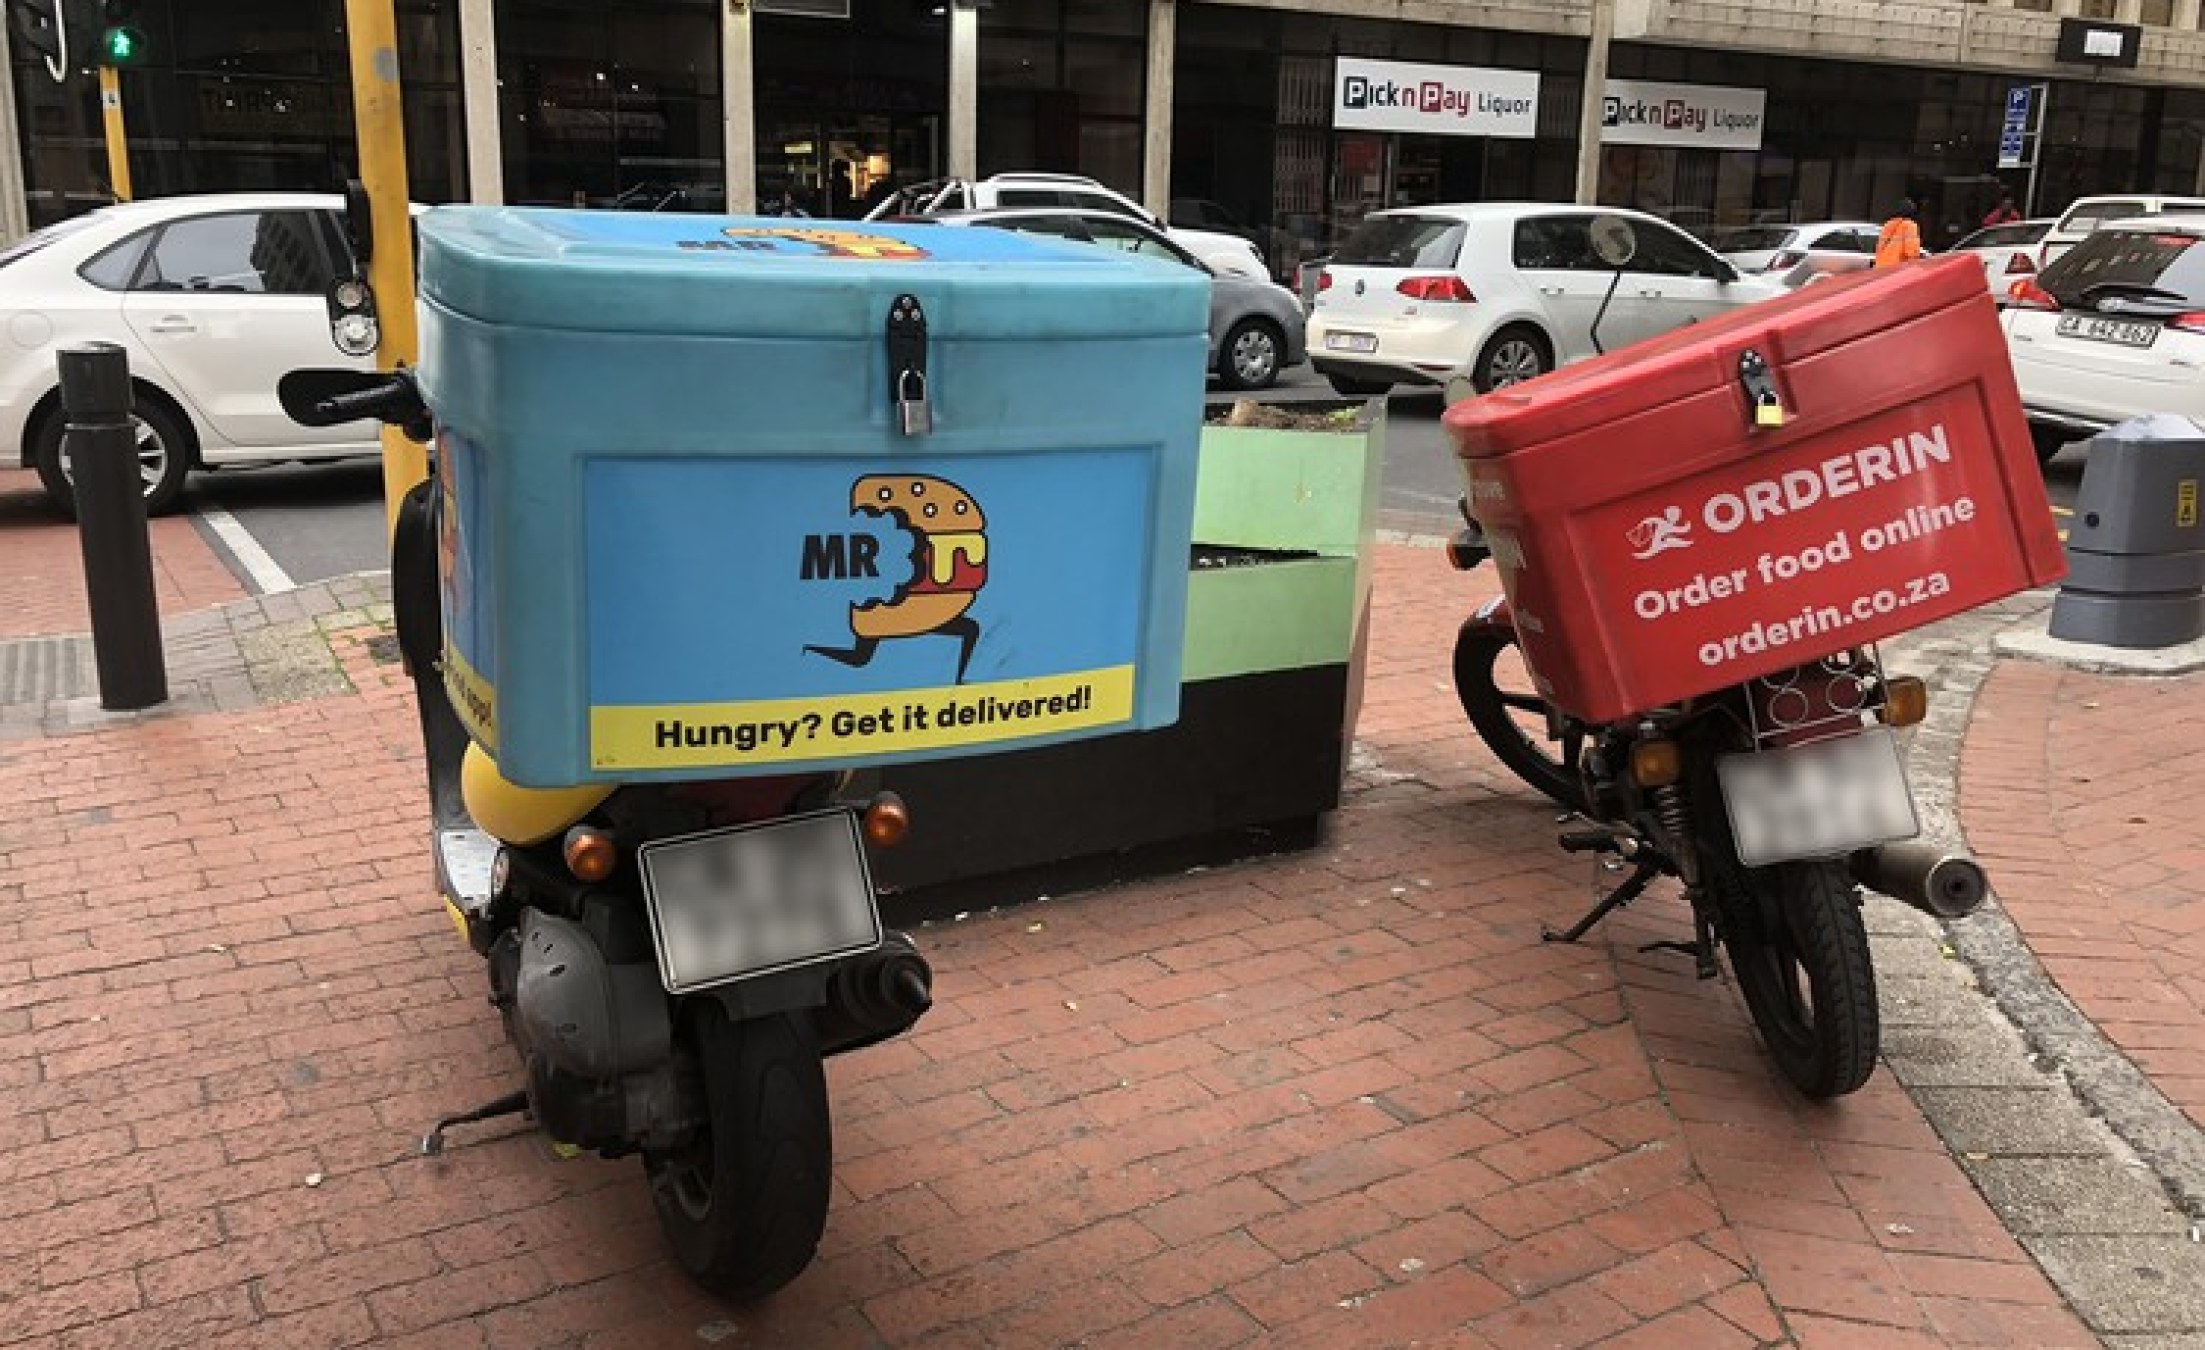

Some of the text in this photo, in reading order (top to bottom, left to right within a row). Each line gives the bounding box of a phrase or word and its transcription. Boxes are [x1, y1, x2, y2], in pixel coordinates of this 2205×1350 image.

[1420, 82, 1471, 118] Pay
[1478, 91, 1533, 118] Liquor
[1664, 100, 1706, 132] Pay
[1714, 109, 1759, 132] Liquor
[1703, 424, 1950, 533] ORDERIN
[800, 534, 880, 580] MR
[1634, 496, 1976, 619] Order food online
[1698, 571, 1950, 666] orderin.co.za
[655, 685, 1092, 751] Hungry? Get it delivered!
